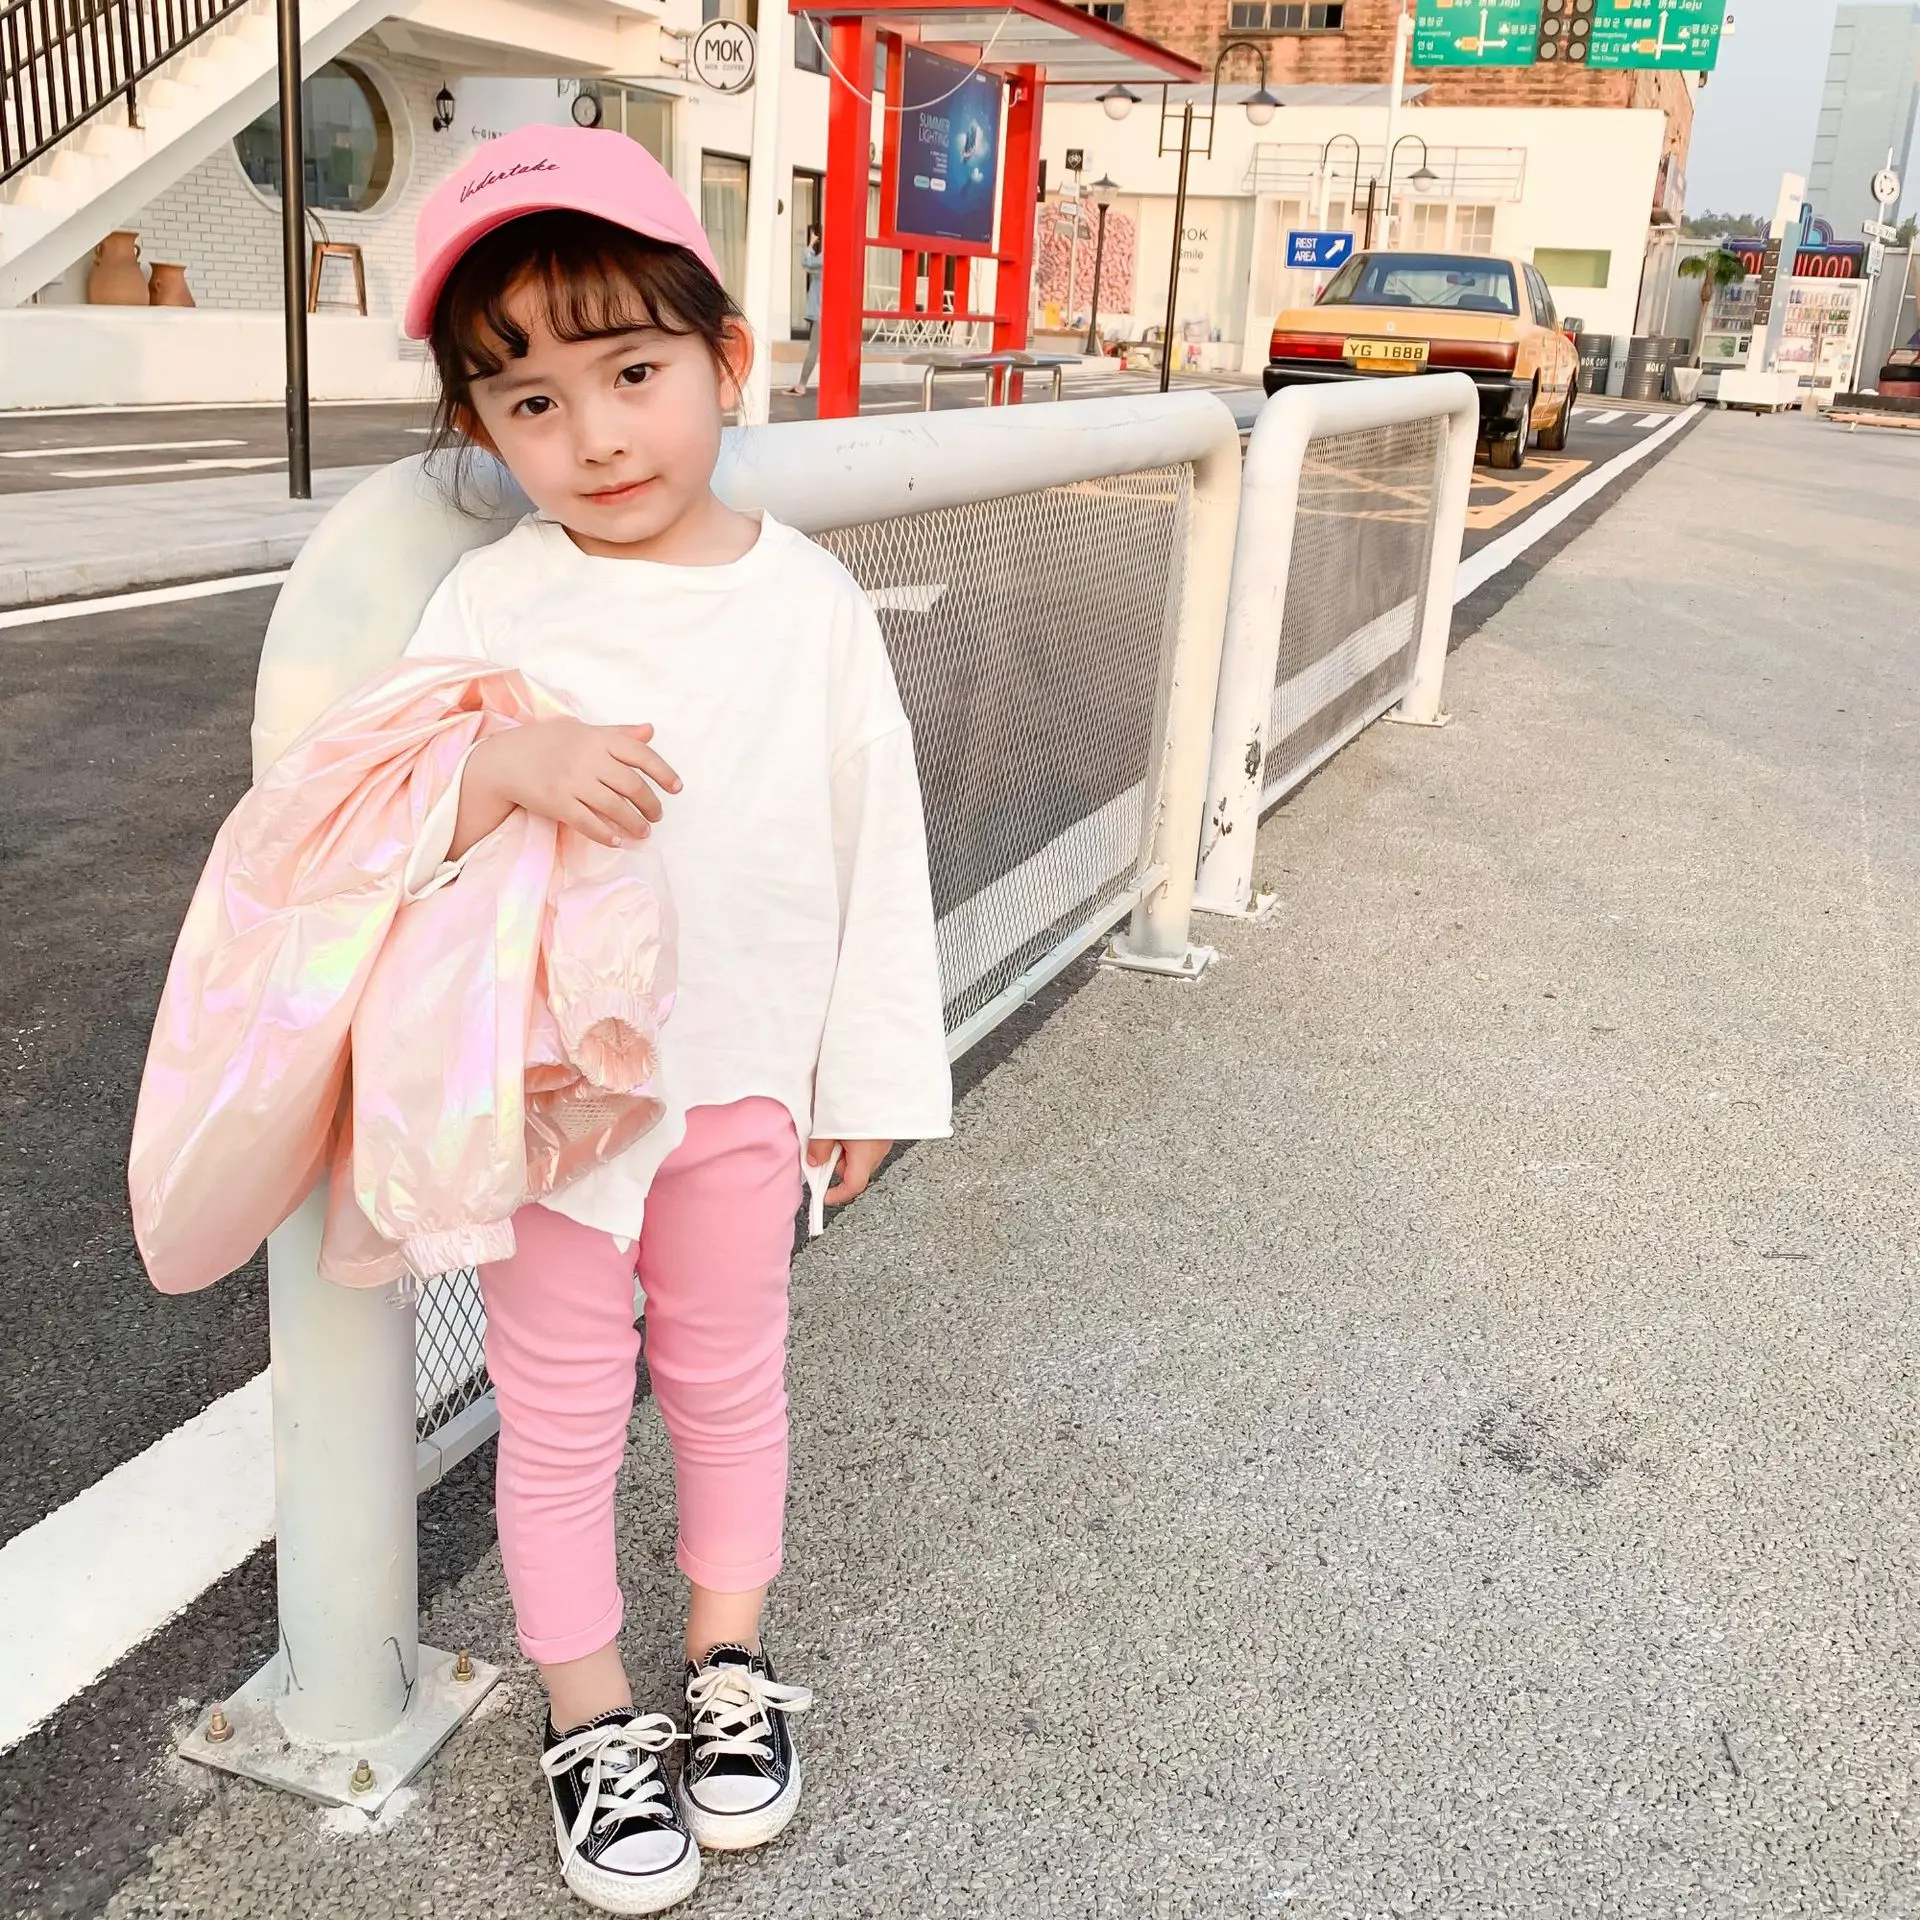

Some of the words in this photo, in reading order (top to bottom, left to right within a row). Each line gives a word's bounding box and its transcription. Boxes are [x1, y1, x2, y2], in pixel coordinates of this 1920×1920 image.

[1679, 0, 1703, 11] Jeju
[705, 39, 744, 62] MOK
[920, 112, 951, 134] SUMMER
[918, 127, 950, 149] LIGHTING
[460, 158, 560, 203] Undertake
[1295, 237, 1319, 249] REST
[1294, 250, 1317, 262] AREA
[1350, 344, 1373, 357] YG
[1383, 346, 1424, 360] 1688
[1645, 361, 1659, 373] MOK
